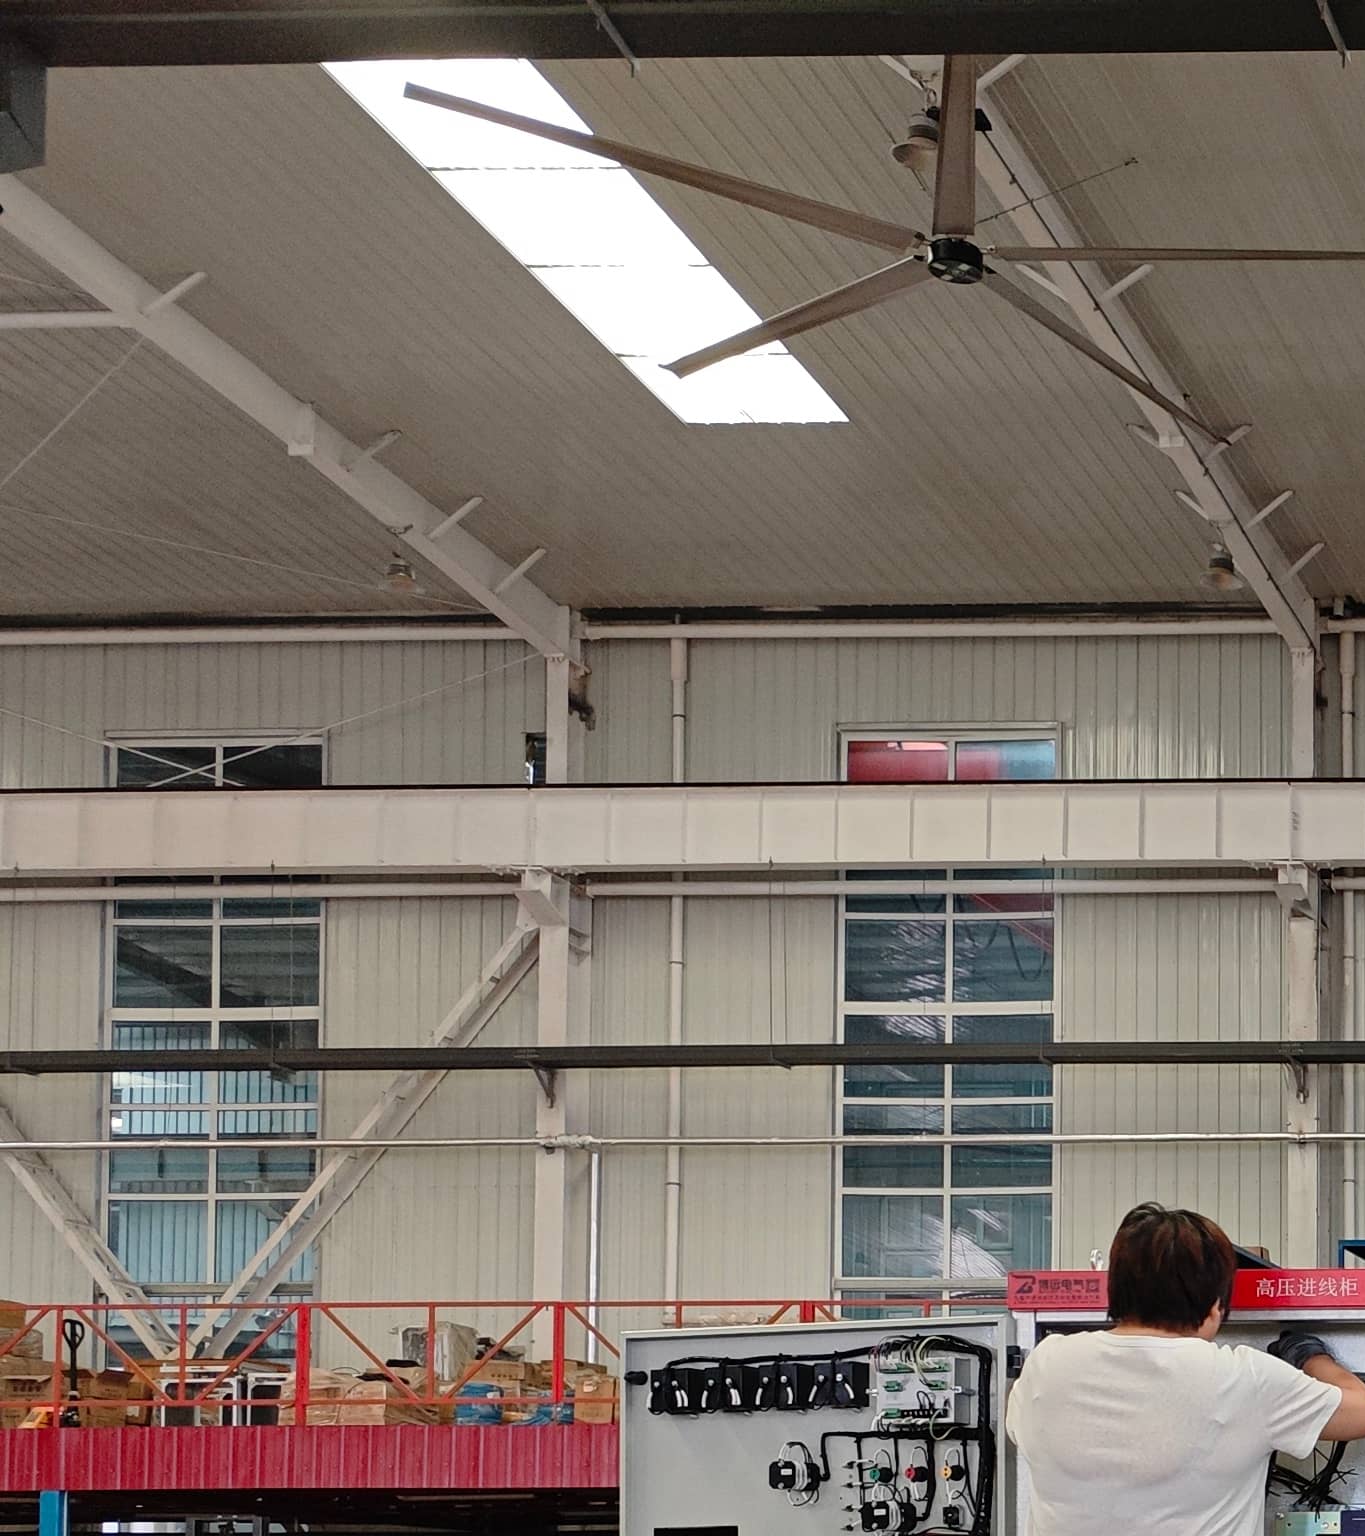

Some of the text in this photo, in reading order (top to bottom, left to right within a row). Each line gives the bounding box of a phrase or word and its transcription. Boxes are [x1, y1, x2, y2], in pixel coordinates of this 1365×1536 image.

[1255, 1277, 1359, 1297] 高压进线柜
